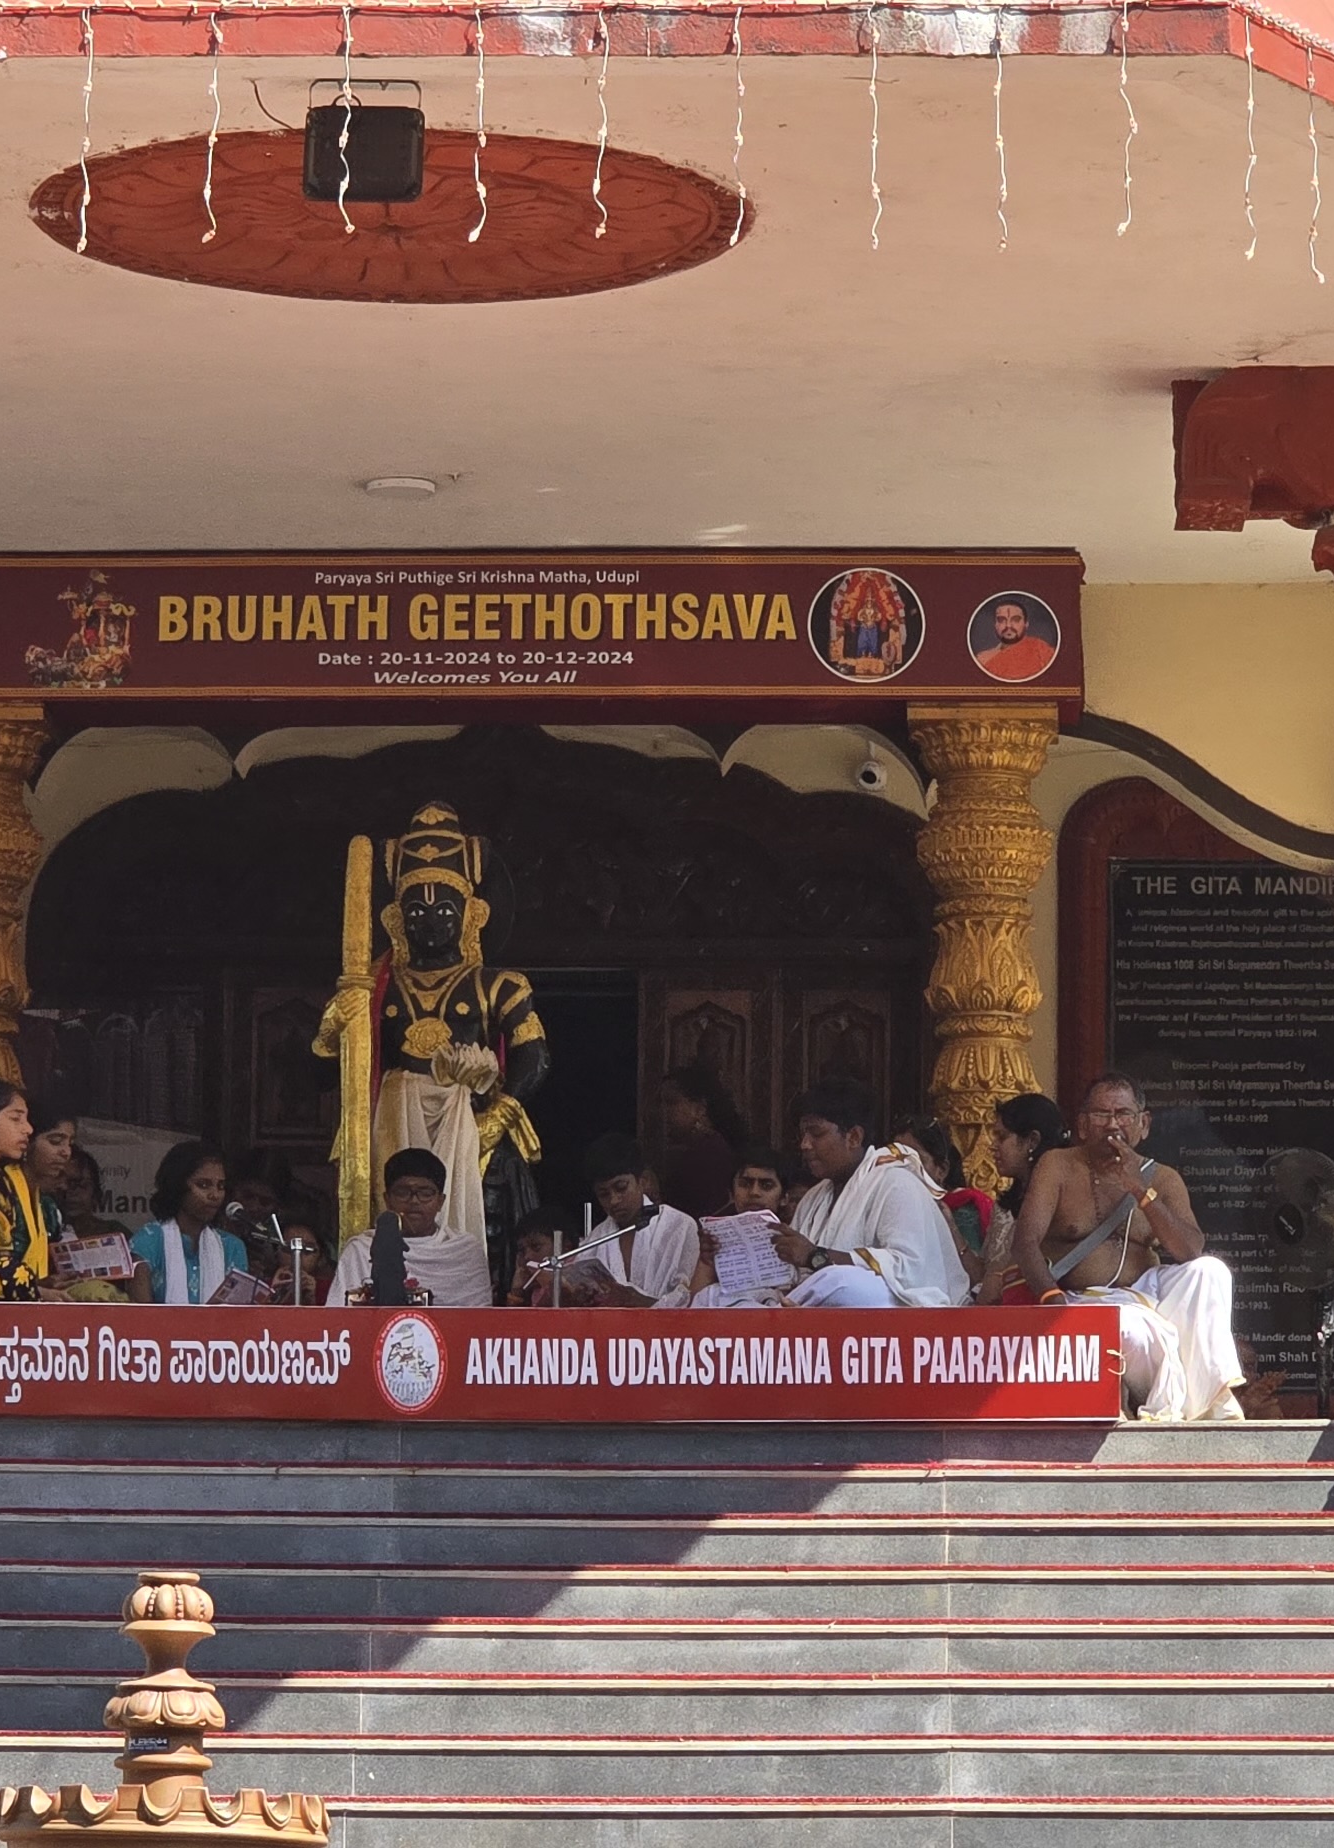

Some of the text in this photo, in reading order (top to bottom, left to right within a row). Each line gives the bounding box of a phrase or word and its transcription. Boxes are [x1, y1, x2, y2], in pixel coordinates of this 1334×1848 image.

[315, 570, 640, 586] Paryaya Sri Puthige Sri Krishna Matha, Udupi
[158, 593, 798, 642] BRUHATH GEETHOTHSAVA
[318, 653, 361, 665] Date
[380, 652, 491, 665] 20-11-2024
[497, 653, 516, 665] to
[522, 652, 634, 664] 20-12-2024
[373, 670, 577, 684] Welcomes You All
[1131, 876, 1177, 895] THE
[1190, 876, 1242, 895] GITA
[1242, 925, 1259, 934] holy
[1116, 960, 1130, 969] His
[1133, 960, 1171, 969] Holiness
[1174, 960, 1194, 969] 1008
[1198, 960, 1210, 969] Sri
[1212, 960, 1225, 969] Sri
[1283, 960, 1321, 969] Theertha
[1133, 1013, 1169, 1021] Founder
[1193, 1013, 1228, 1021] Founder
[1231, 1013, 1272, 1021] President
[1158, 1029, 1186, 1038] during
[1188, 1029, 1201, 1037] his
[1204, 1029, 1235, 1037] second
[1237, 1029, 1271, 1038] Paryaya
[1212, 1061, 1239, 1072] Pooja
[1241, 1061, 1291, 1072] performed
[1293, 1061, 1305, 1071] by
[1139, 1080, 1172, 1090] oliness
[1197, 1080, 1210, 1090] Sri
[1212, 1080, 1225, 1090] Sri
[1282, 1080, 1321, 1090] Theertha
[1179, 1147, 1234, 1155] Foundation
[1236, 1147, 1264, 1155] Stone
[1182, 1166, 1231, 1176] Shankar
[1252, 1333, 1285, 1341] Mandir
[1288, 1333, 1312, 1341] done
[97, 1325, 161, 1384] ಗೀತಾ
[169, 1329, 351, 1385] ಪಾರಾಯಣಮ್
[465, 1338, 598, 1386] AKHANDA
[609, 1337, 833, 1386] UDAYASTAMANA
[842, 1336, 904, 1385] GITA
[913, 1334, 1100, 1384] PAARAYANAM
[1279, 1352, 1308, 1362] Shah
